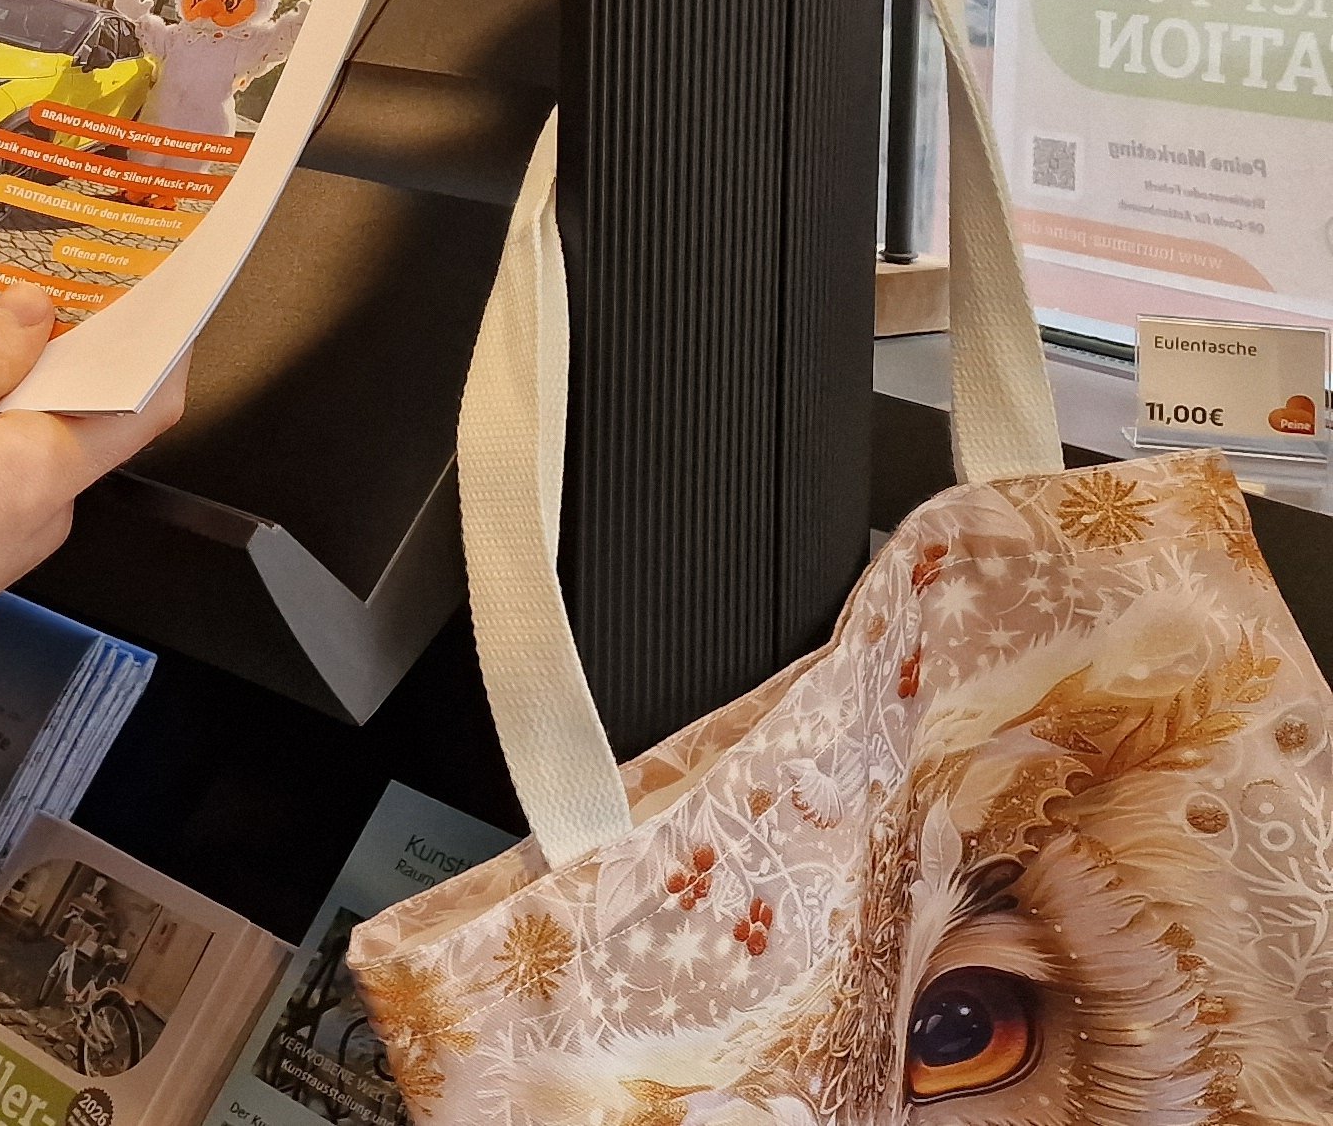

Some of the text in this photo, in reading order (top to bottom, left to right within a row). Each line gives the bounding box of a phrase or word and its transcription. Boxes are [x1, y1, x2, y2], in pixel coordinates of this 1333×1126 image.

[41, 108, 233, 156] BRAWO Mobility Spring bewegt Peine
[20, 146, 41, 160] neu
[42, 151, 83, 171] erleben
[84, 161, 101, 175] bei
[103, 165, 121, 179] der
[121, 170, 153, 185] Silent
[154, 176, 185, 190] Music
[185, 180, 214, 195] Party
[4, 184, 183, 230] STADTRADELN für den Klimaschutz
[61, 245, 130, 266] Offene Pforte
[64, 290, 104, 304] gesucht
[1154, 335, 1257, 357] Eulentasche
[1145, 402, 1224, 427] 11,00€
[1280, 419, 1312, 432] Peine
[278, 1032, 394, 1103] VERWOBENE WELT
[280, 1057, 373, 1121] Kunstausstellung
[78, 1093, 110, 1126] 2026
[229, 1101, 251, 1120] Der
